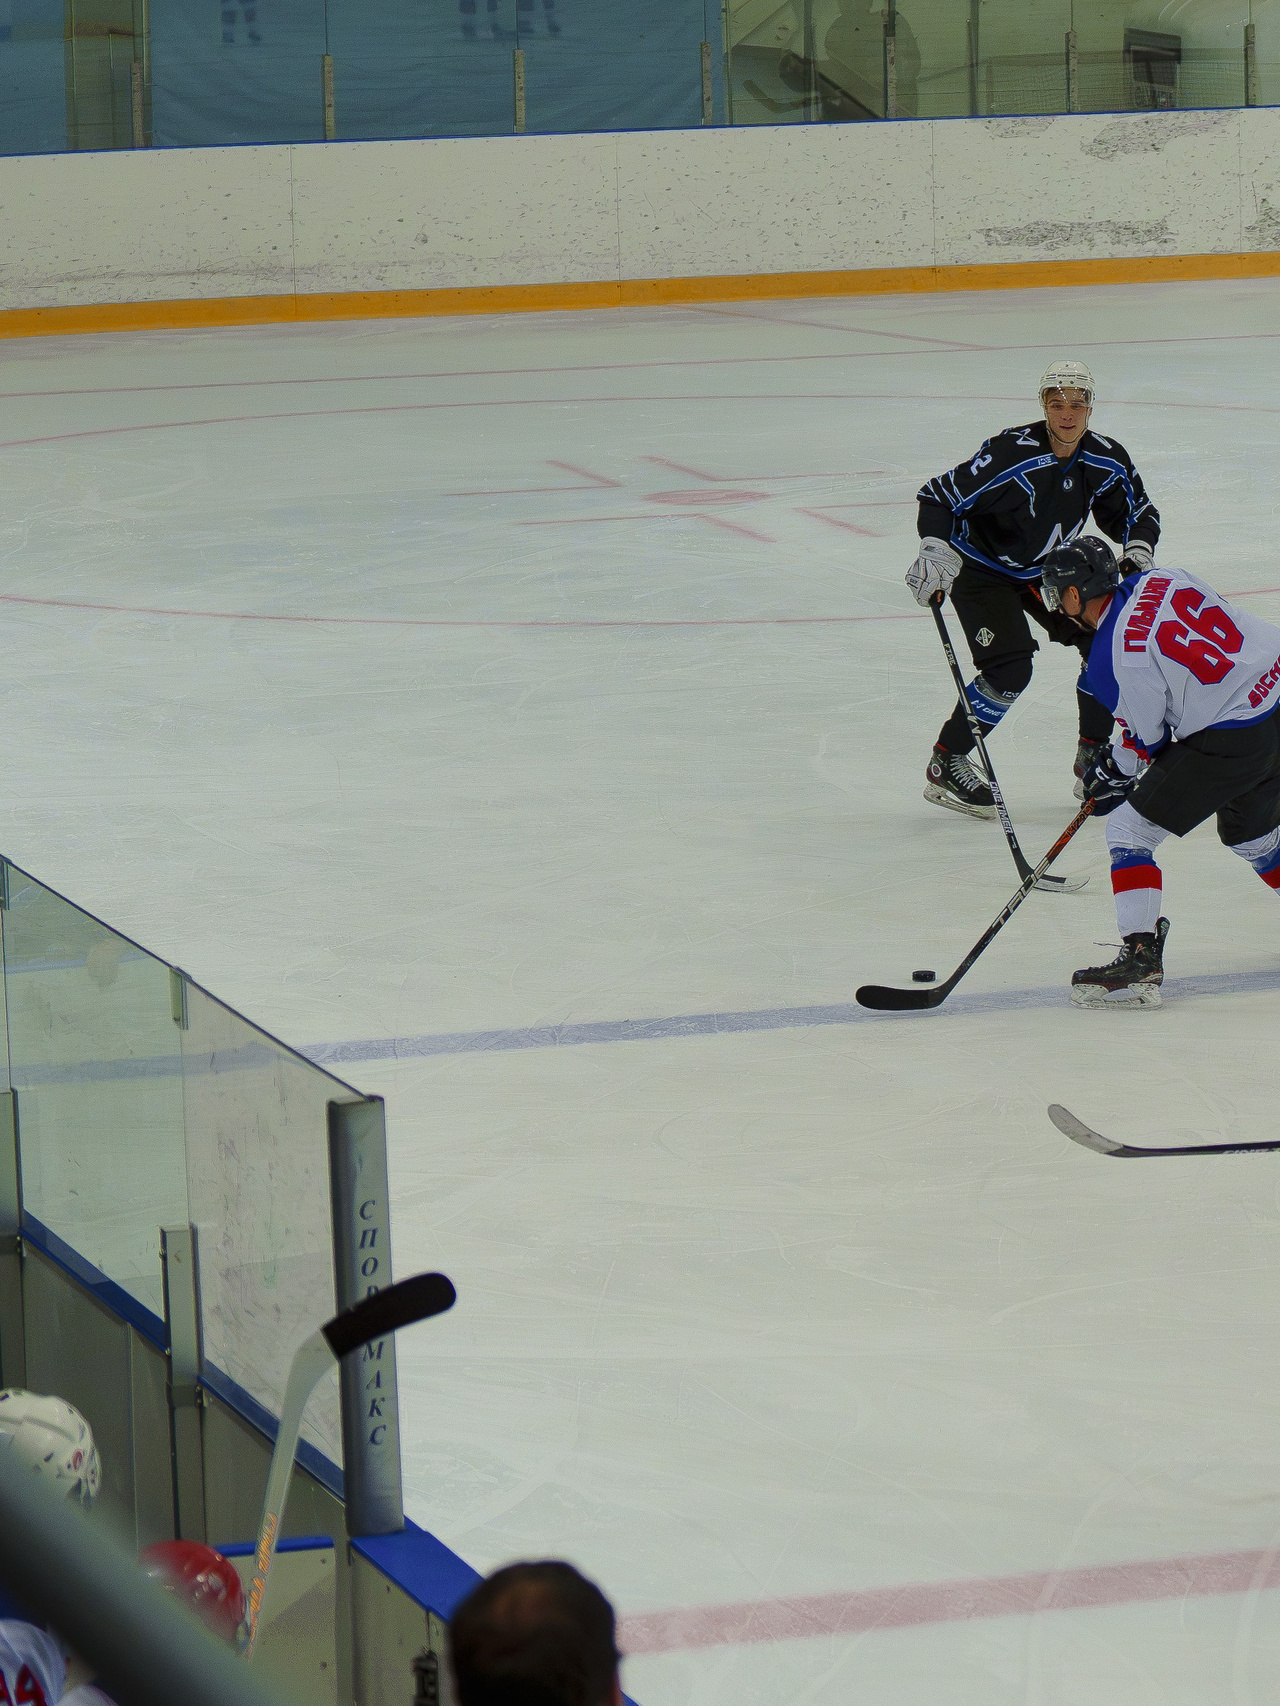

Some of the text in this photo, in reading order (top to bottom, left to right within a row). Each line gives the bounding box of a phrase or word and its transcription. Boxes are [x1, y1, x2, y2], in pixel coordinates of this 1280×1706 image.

[1123, 577, 1174, 653] ГИЛЬМАНО
[1155, 587, 1245, 686] 66
[991, 857, 1050, 928] TRUE
[358, 1200, 387, 1446] СПОМАКС
